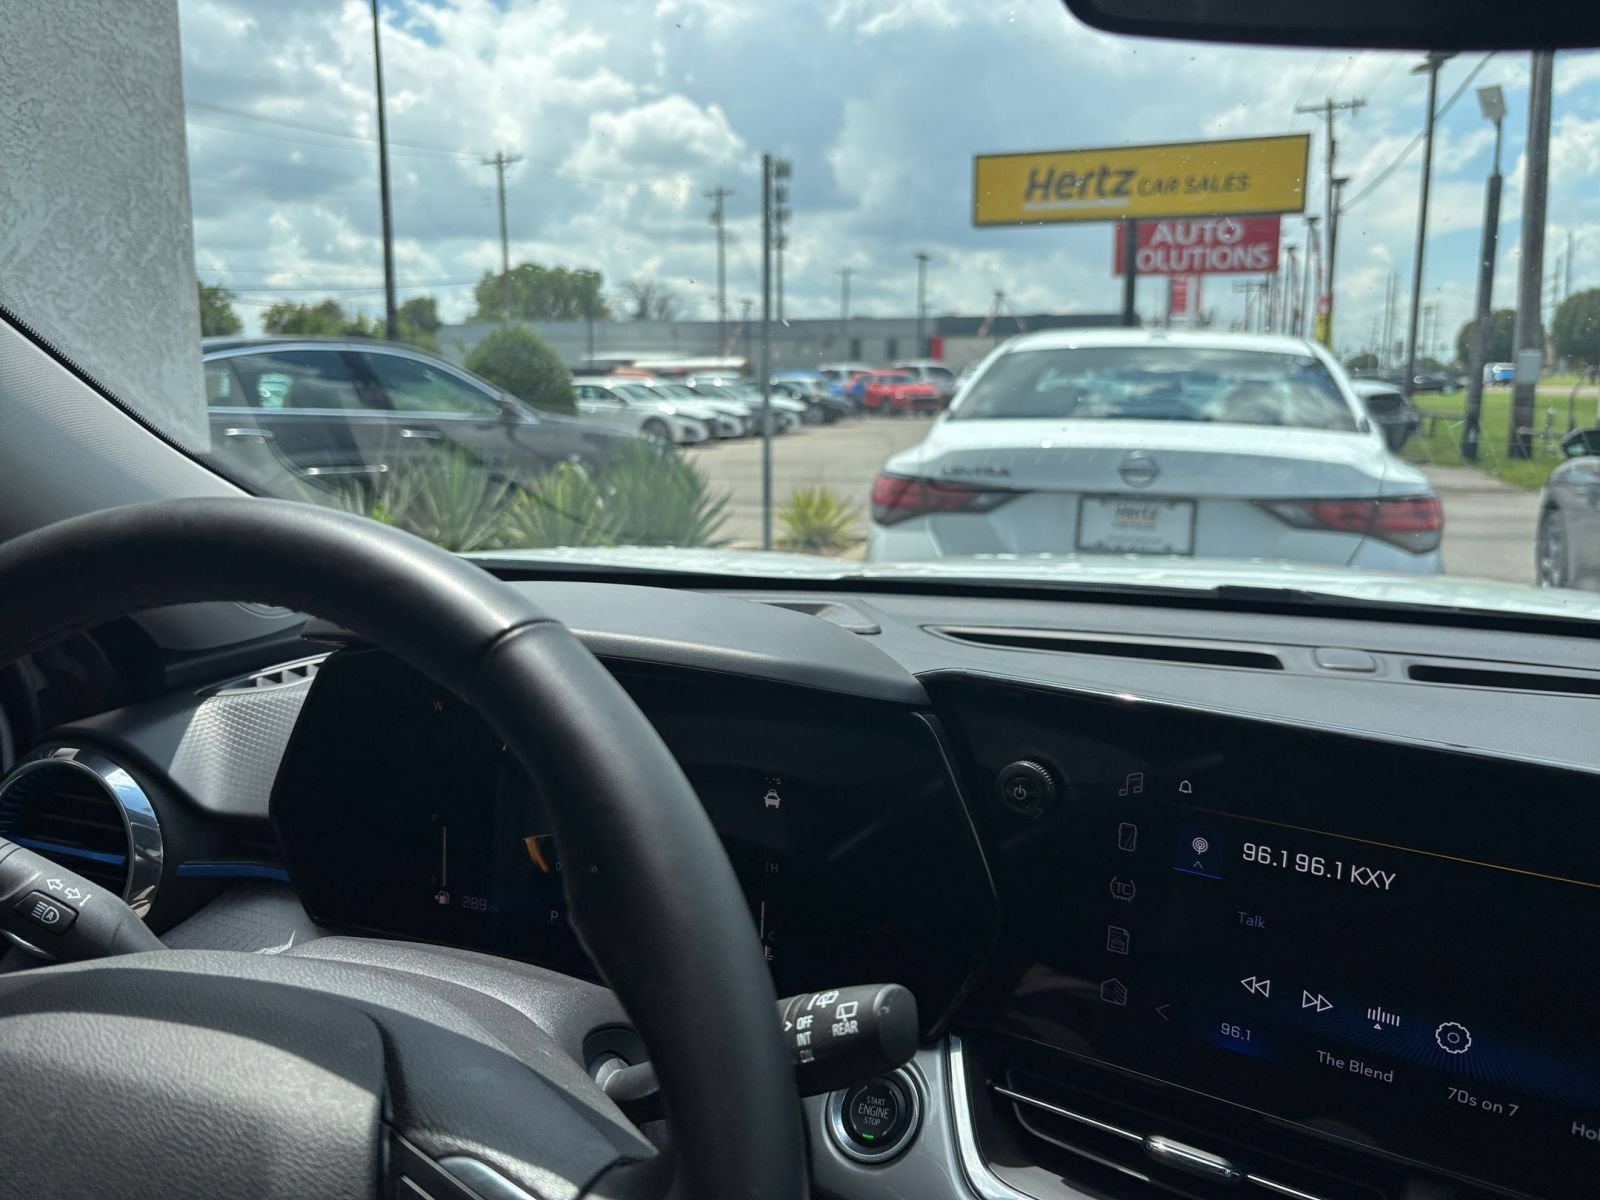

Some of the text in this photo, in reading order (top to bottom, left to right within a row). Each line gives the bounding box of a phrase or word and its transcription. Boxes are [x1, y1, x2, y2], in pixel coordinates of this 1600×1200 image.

[1025, 164, 1250, 201] Hertz CAR SALES
[1150, 218, 1244, 246] AUTO
[1135, 246, 1270, 273] OLUTIONS
[1242, 842, 1396, 892] 96.1 96.1 KXY
[1238, 911, 1266, 930] Talk
[796, 1015, 814, 1031] OFF
[832, 1021, 859, 1037] REAR
[1220, 1021, 1252, 1042] 96.1
[797, 1032, 812, 1047] INT
[1316, 1050, 1394, 1084] The Blend
[866, 1095, 886, 1106] START
[1447, 1087, 1519, 1118] 70s on 7
[858, 1103, 889, 1119] ENGINE
[864, 1116, 881, 1126] STOP
